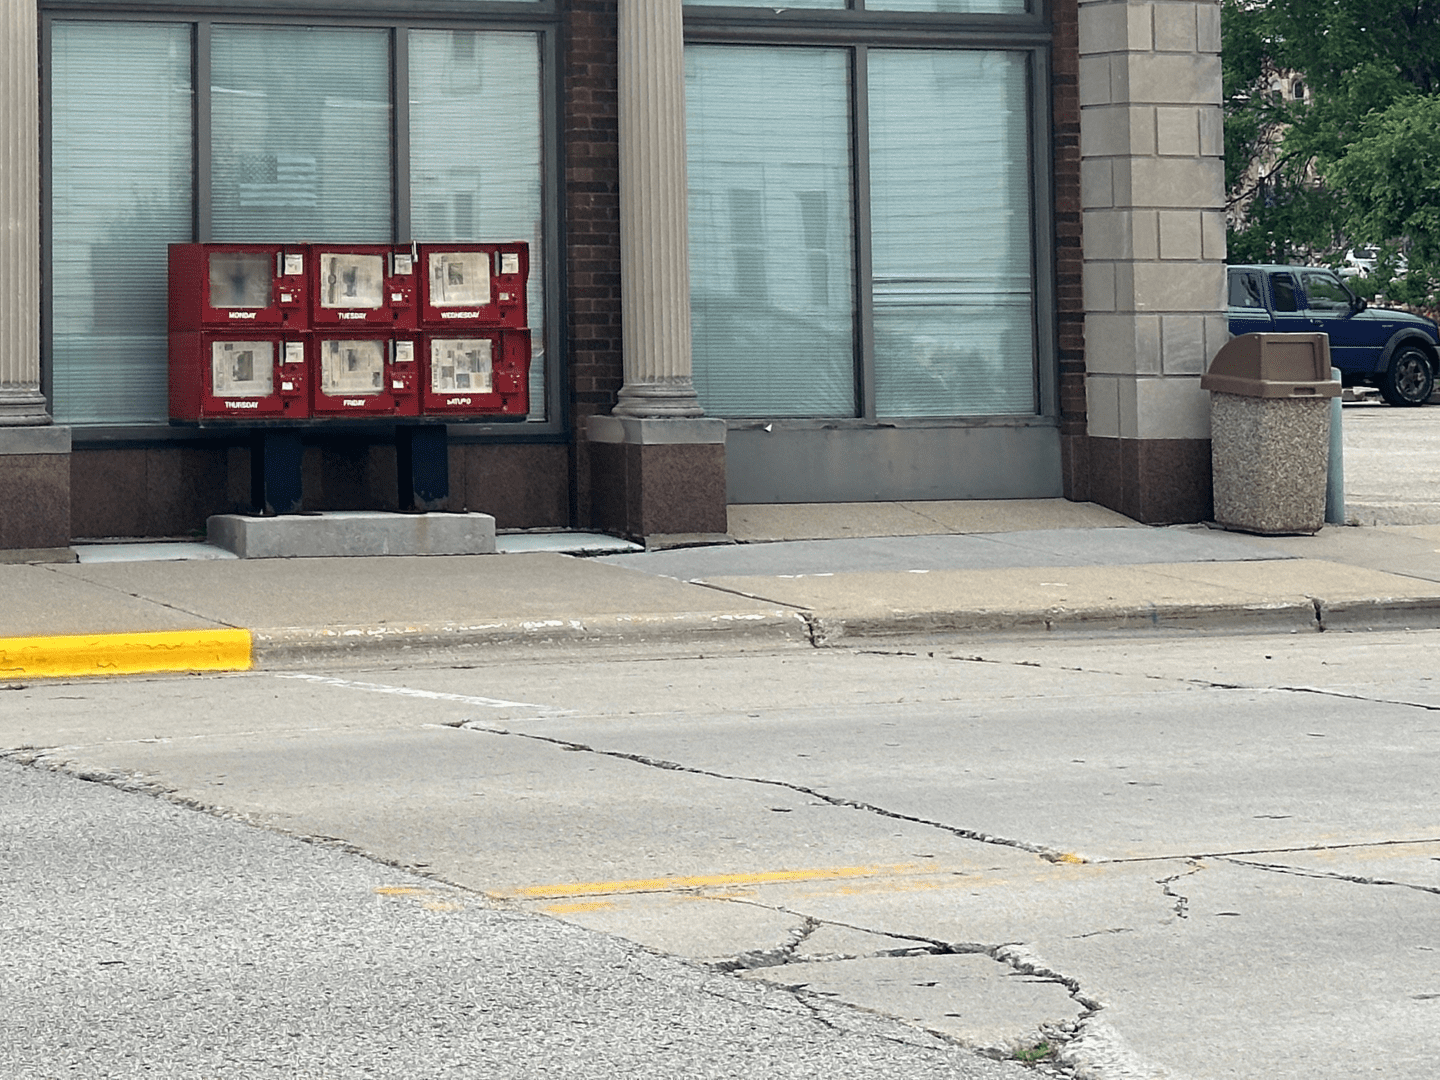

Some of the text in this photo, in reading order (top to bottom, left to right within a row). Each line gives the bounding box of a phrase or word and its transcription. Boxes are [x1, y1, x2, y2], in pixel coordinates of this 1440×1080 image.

[228, 311, 257, 319] MONDAY
[337, 312, 367, 320] TUESDAY
[440, 311, 480, 319] WEDNESDAY
[224, 401, 259, 409] THURSDAY
[343, 399, 366, 407] FRIDAY
